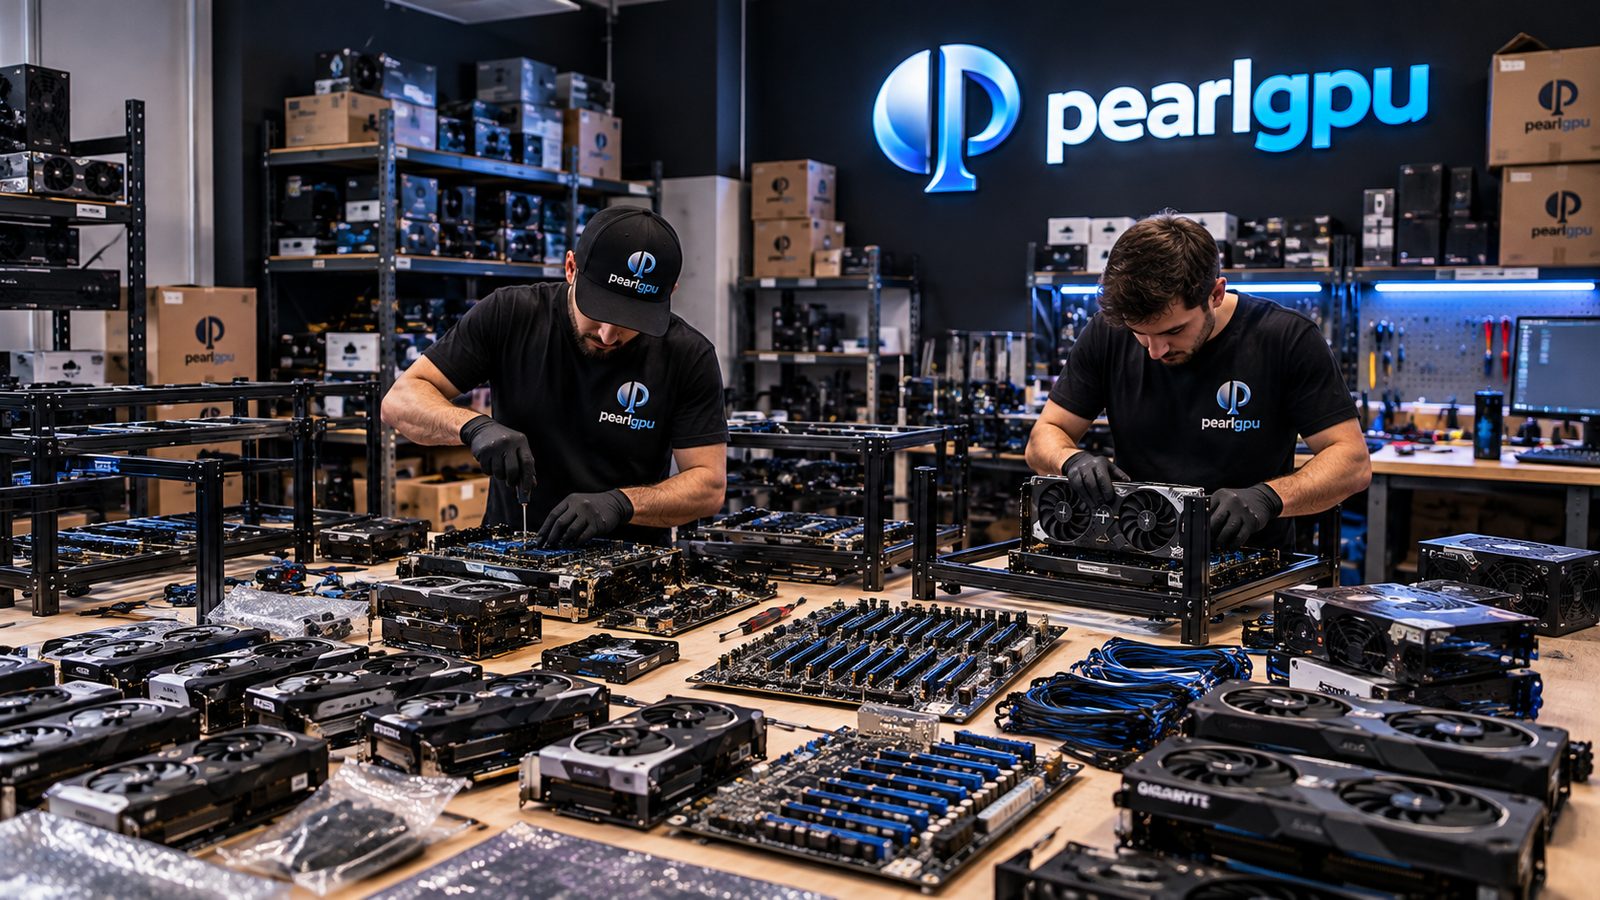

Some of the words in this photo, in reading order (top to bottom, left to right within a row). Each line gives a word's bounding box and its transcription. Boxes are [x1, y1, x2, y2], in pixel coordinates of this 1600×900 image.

[1046, 58, 1430, 165] pearlgpu
[1525, 117, 1591, 134] pearlgpu
[1531, 224, 1592, 239] pearlgpu
[608, 273, 659, 294] pearlgpu
[185, 352, 234, 366] pearlgpu
[599, 411, 655, 430] pearlgpu
[1201, 417, 1260, 432] pearlgpu
